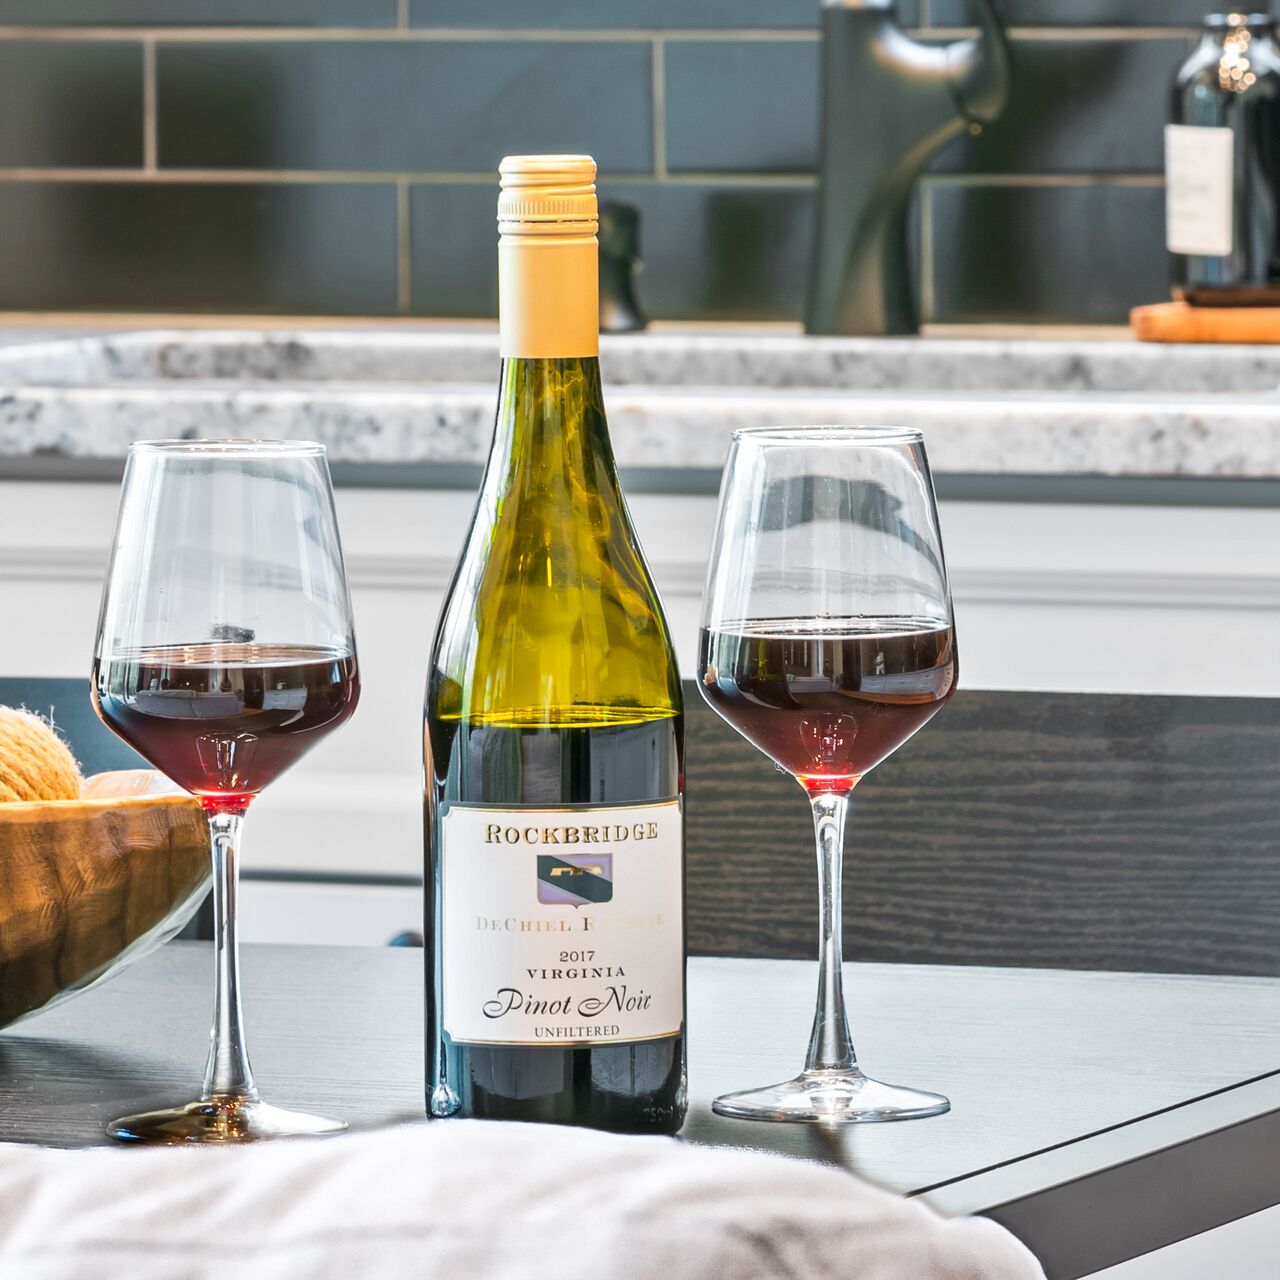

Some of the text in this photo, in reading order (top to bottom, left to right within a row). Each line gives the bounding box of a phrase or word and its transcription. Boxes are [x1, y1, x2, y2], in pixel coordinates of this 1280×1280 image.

[484, 821, 659, 845] ROCKBRIDGE
[559, 950, 595, 962] 2017
[526, 967, 626, 980] VIRGINIA
[482, 985, 652, 1020] Pinot Noir
[534, 1024, 620, 1038] UNFILTERED
